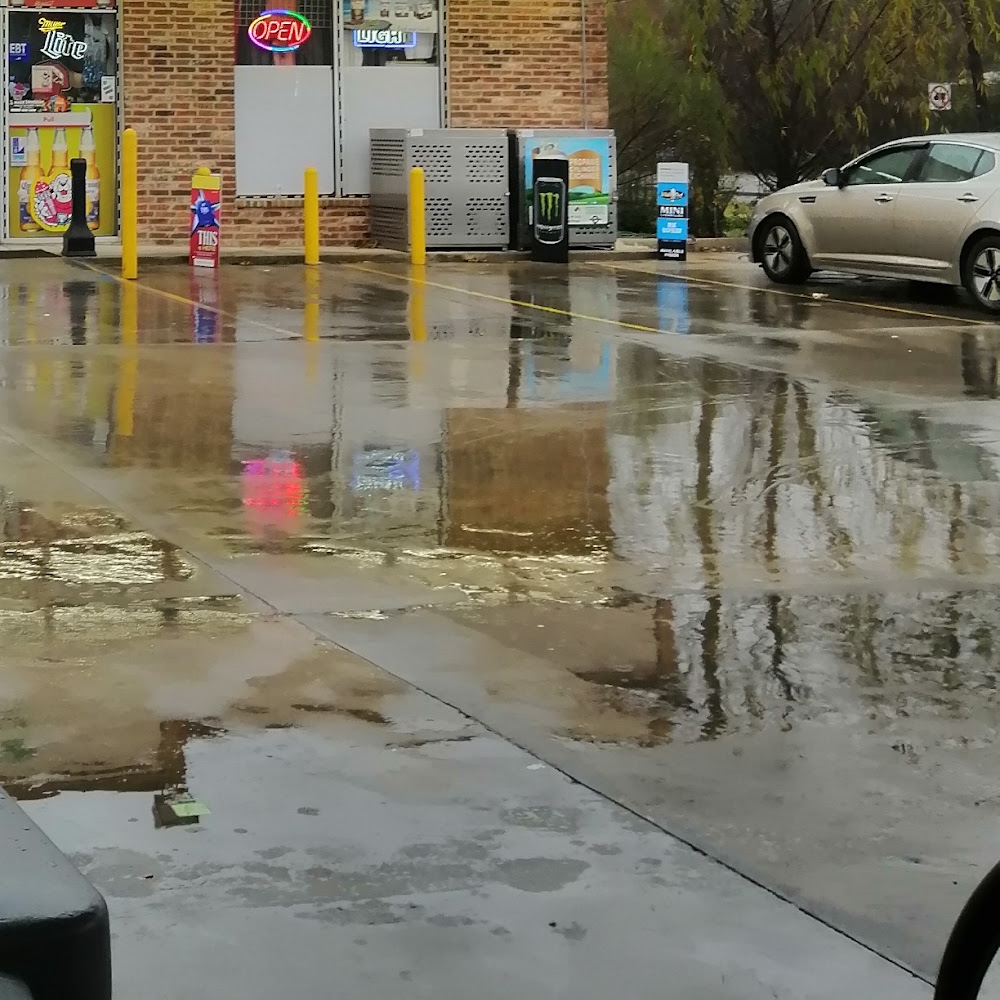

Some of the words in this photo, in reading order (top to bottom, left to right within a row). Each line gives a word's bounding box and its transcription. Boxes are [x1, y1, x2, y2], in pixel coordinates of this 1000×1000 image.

[252, 20, 305, 42] OPEN
[9, 42, 27, 54] EBT
[40, 30, 88, 60] Lite
[660, 206, 685, 215] MINI
[197, 230, 218, 246] THIS
